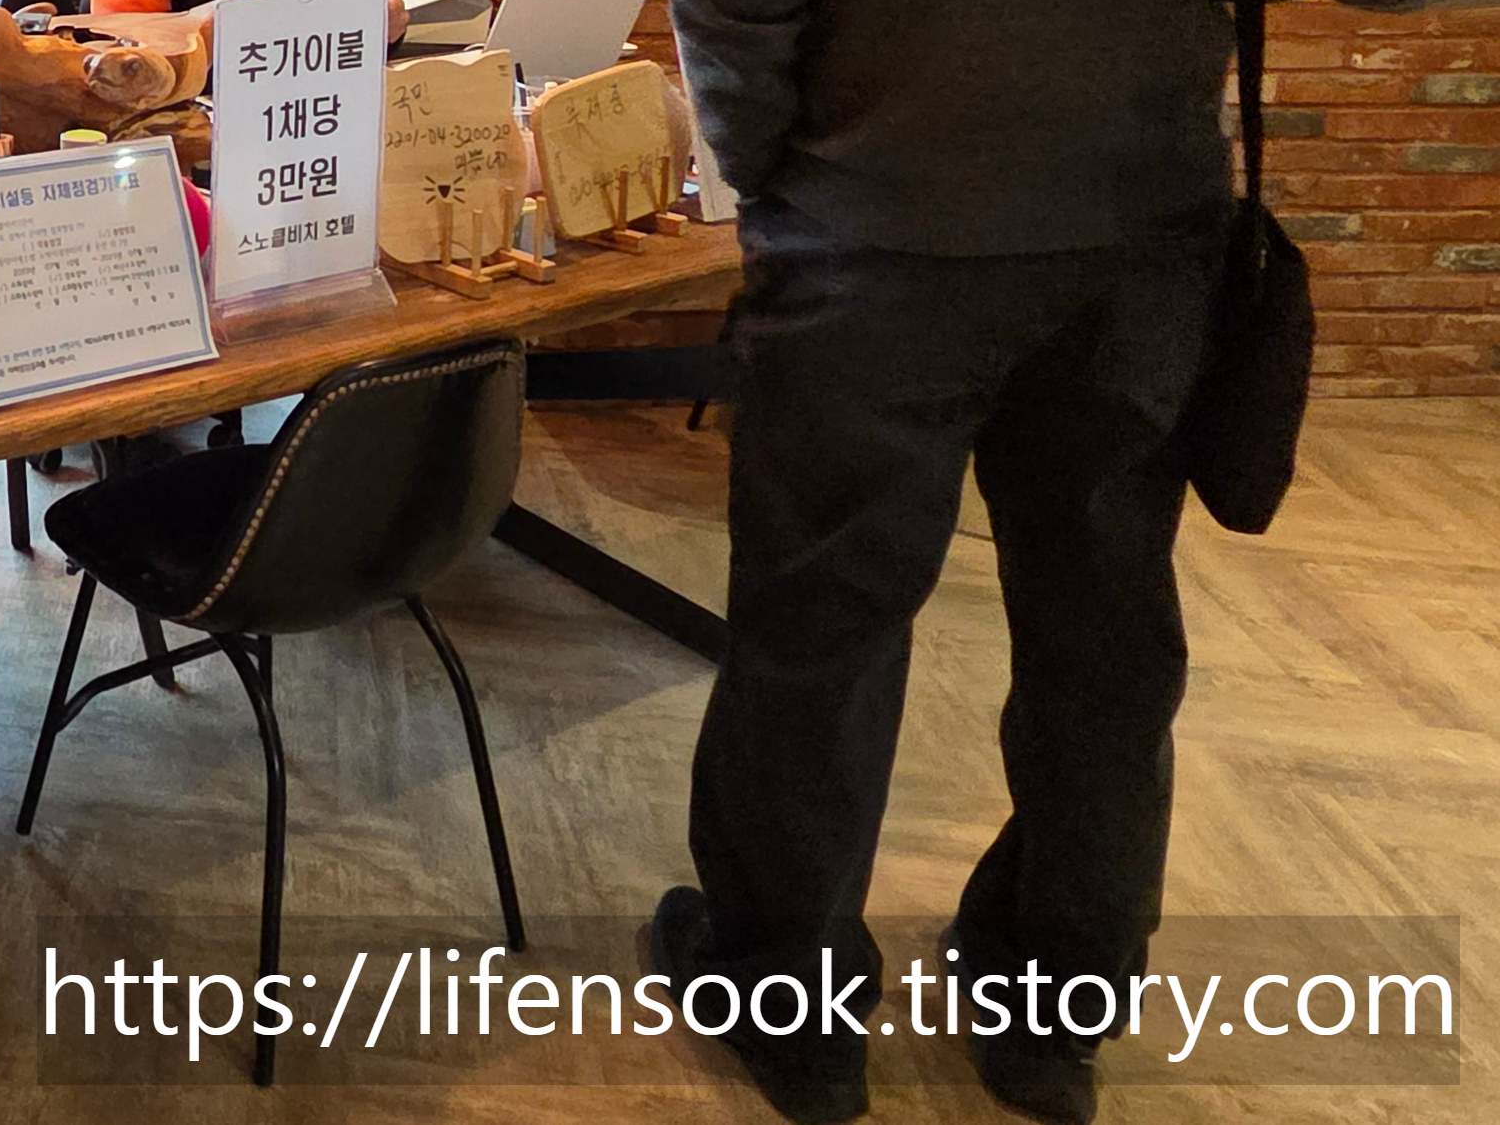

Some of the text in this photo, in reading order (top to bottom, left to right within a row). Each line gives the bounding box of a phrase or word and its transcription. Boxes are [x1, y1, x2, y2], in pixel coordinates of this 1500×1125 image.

[238, 29, 365, 83] 추가이불
[262, 93, 342, 142] 1채당
[392, 81, 433, 124] 국민
[257, 155, 338, 207] 3만원
[325, 214, 355, 238] 호텔
